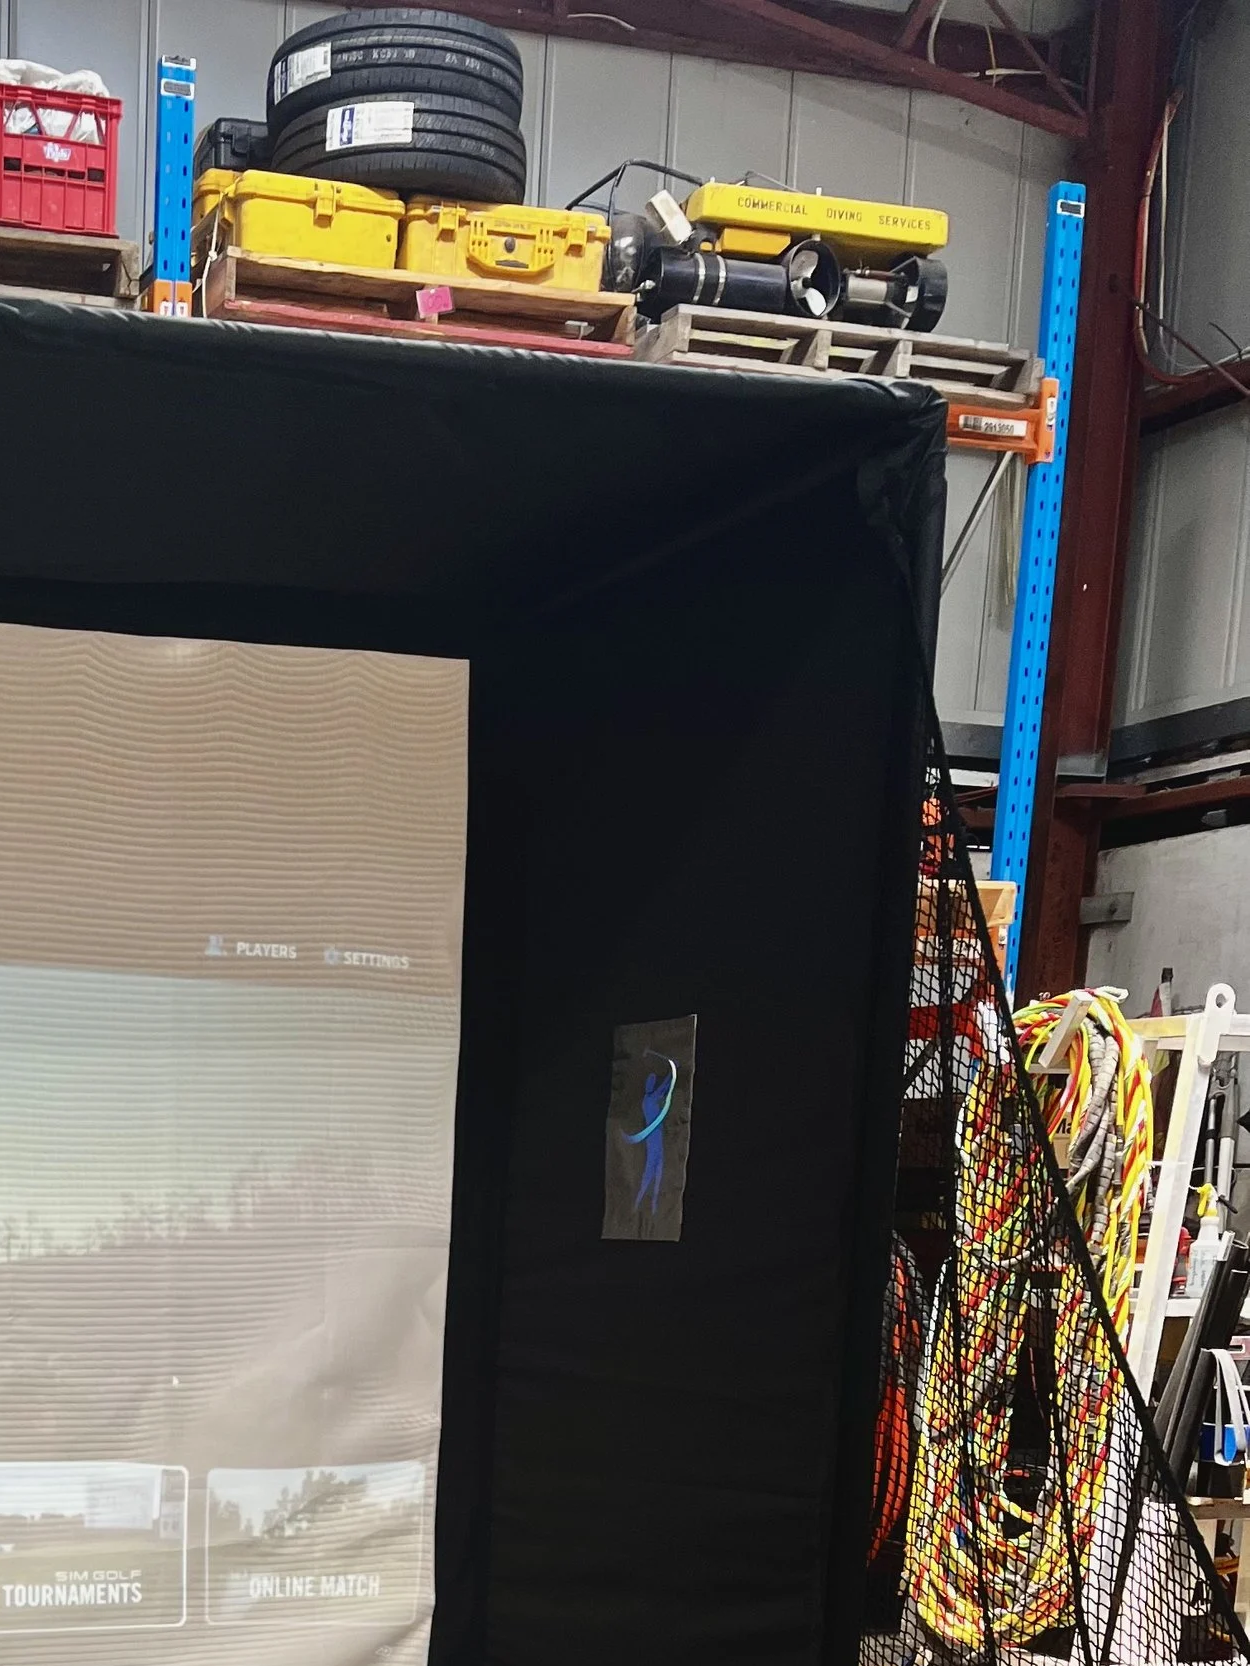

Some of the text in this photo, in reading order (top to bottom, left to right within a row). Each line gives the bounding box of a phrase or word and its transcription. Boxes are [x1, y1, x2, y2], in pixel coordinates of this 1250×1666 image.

[737, 196, 932, 231] COMMERCIAL DIVING SERVICES
[236, 941, 298, 960] PLAYERS
[342, 951, 411, 970] SETTINGS
[55, 1569, 143, 1583] SIM GOLF
[249, 1573, 381, 1599] ONLINE MATCH
[2, 1582, 143, 1607] TOURNAMENTS
